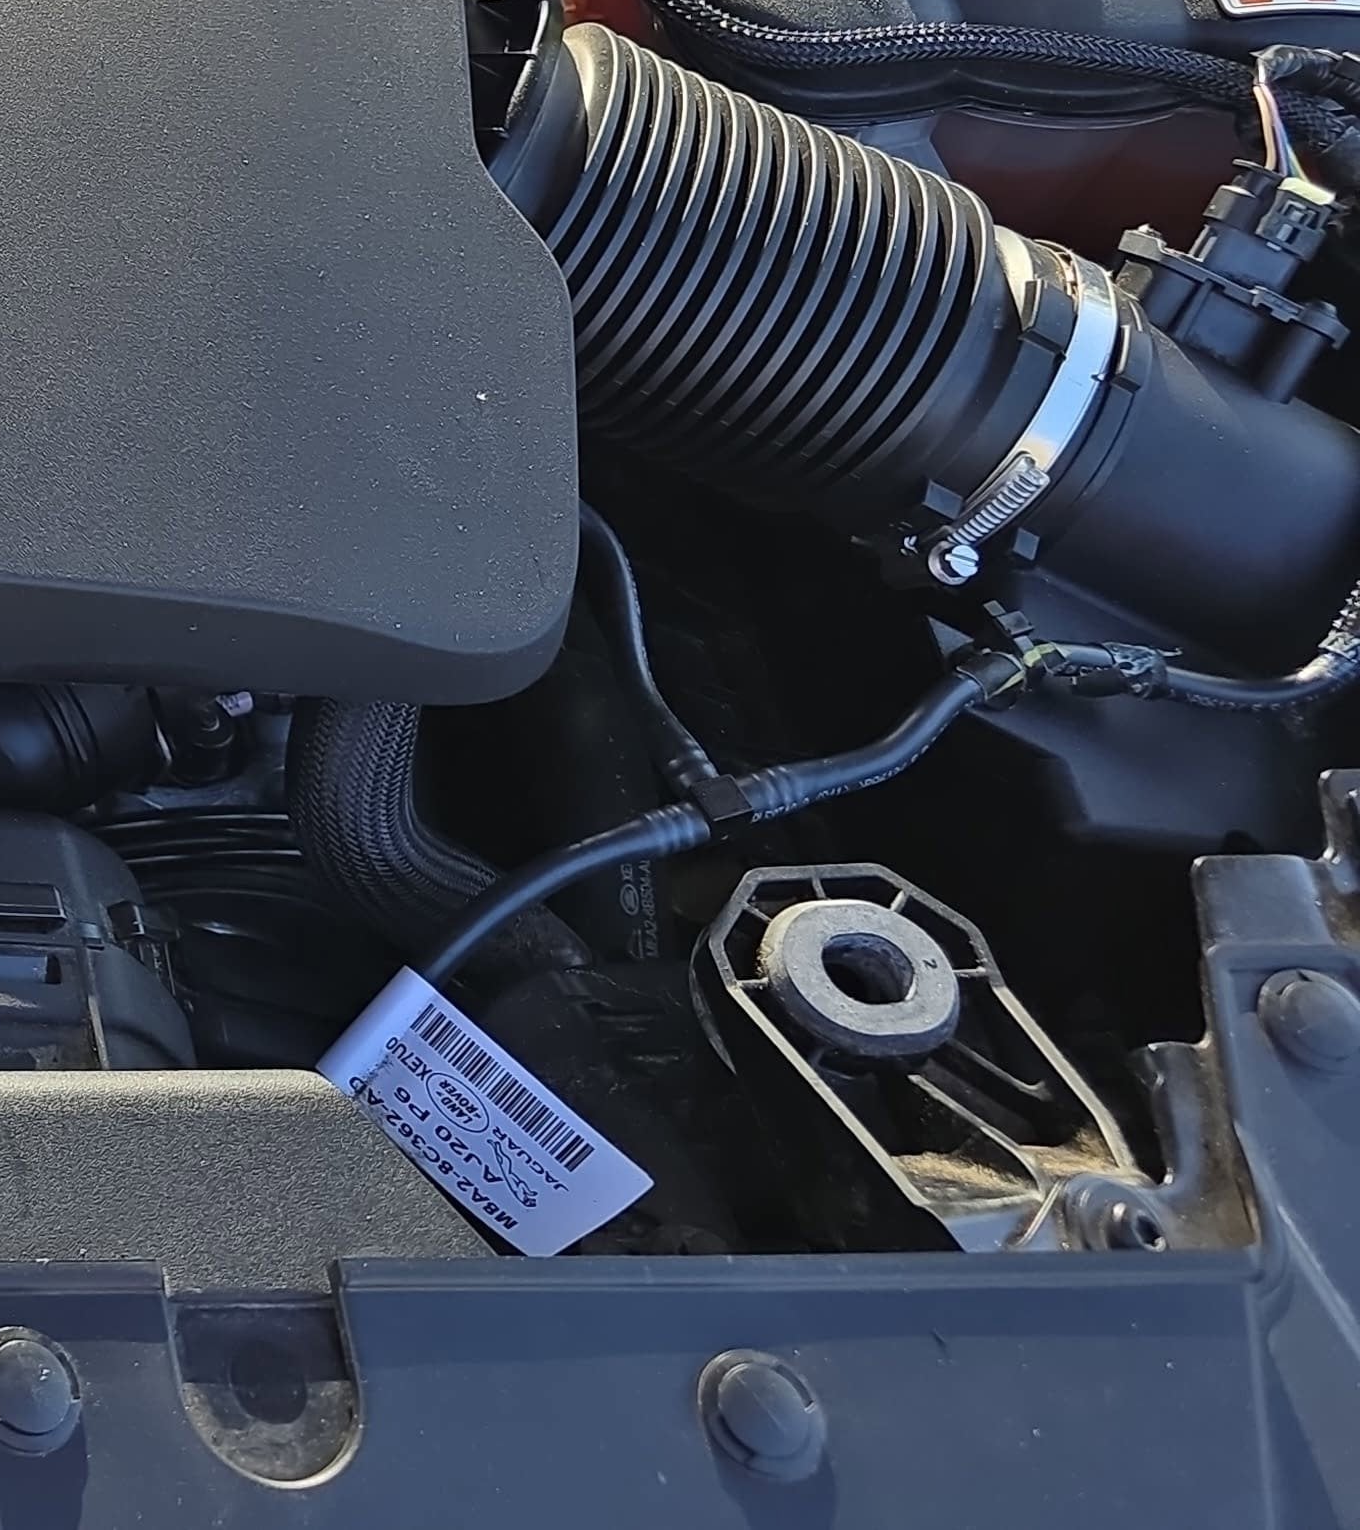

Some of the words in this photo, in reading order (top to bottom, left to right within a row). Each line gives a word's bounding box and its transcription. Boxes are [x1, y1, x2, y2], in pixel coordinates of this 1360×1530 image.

[393, 1085, 430, 1122] P6
[348, 1075, 519, 1230] M8A2-8C362-AD
[435, 1124, 504, 1184] AJ20
[492, 1126, 569, 1192] JAGUAR
